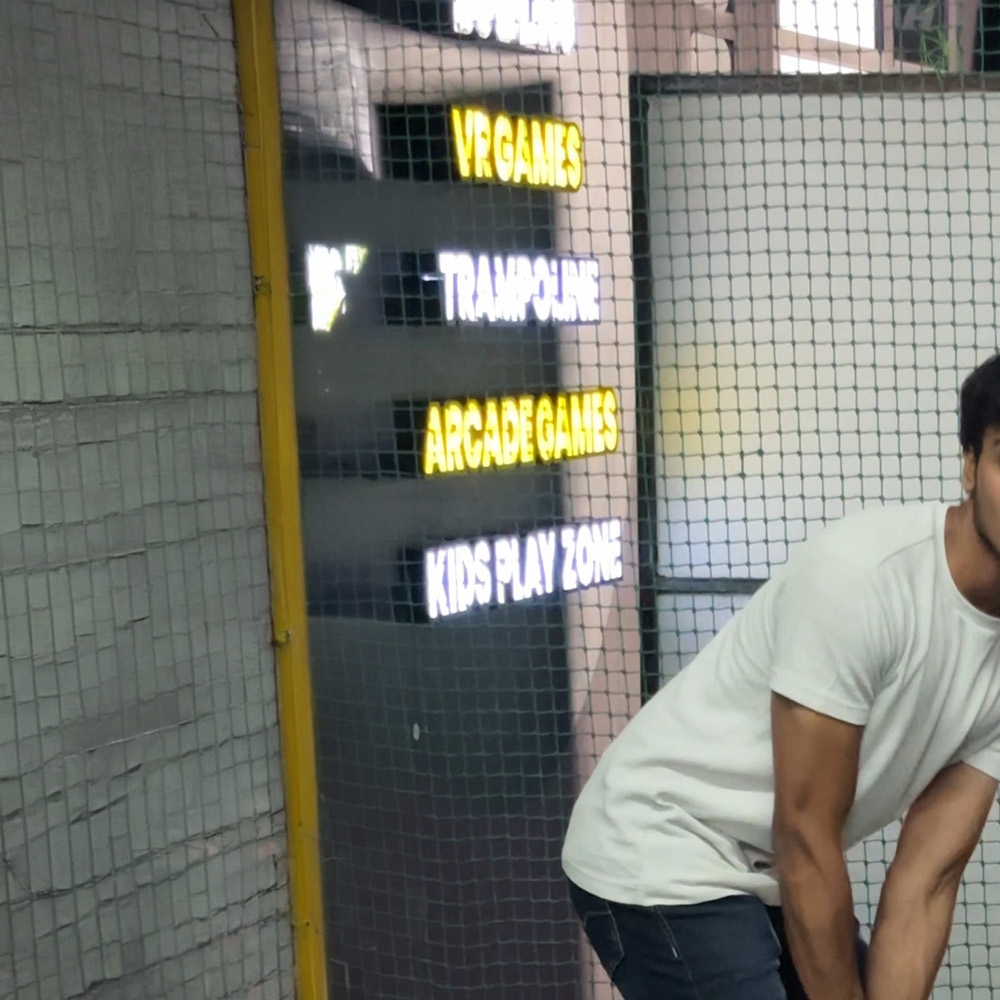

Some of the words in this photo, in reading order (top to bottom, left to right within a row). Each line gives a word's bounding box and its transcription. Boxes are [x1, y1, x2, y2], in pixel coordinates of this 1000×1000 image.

[451, 107, 493, 179] VR
[493, 113, 583, 190] GAMES
[437, 251, 600, 322] TRAMPOLINE
[424, 398, 535, 475] ARCADE
[535, 389, 618, 460] GAMES
[425, 539, 493, 620] KIDS
[494, 530, 556, 605] PLAY
[561, 518, 622, 592] ZONE
